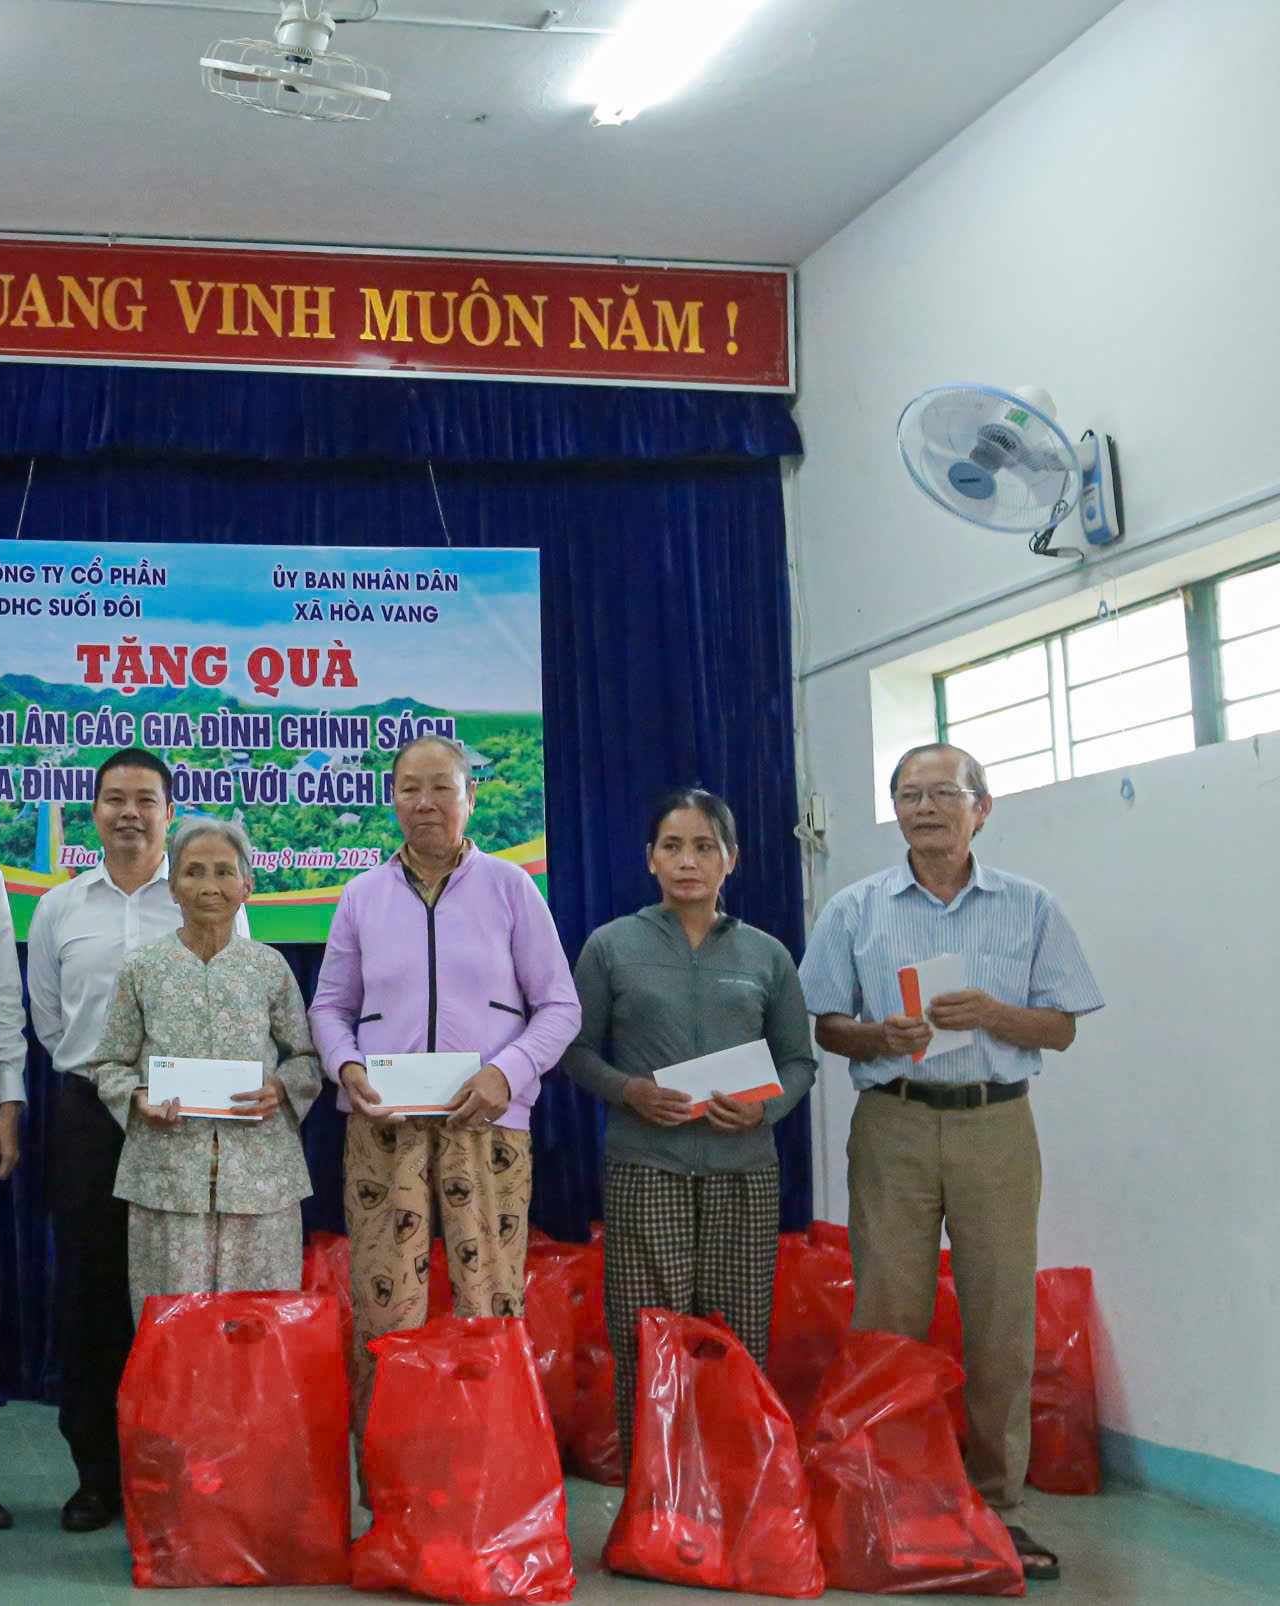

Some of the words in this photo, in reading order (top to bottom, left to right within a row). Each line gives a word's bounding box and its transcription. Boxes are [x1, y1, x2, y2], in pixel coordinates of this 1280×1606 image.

[170, 279, 336, 339] VINH
[359, 277, 548, 349] MUÔN
[569, 284, 705, 354] NĂM
[726, 301, 738, 355] !
[41, 566, 64, 584] TY
[70, 557, 104, 585] CỔ
[110, 559, 166, 586] PHẦN
[273, 564, 298, 589] ỦY
[305, 571, 346, 590] BAN
[352, 568, 409, 591] NHÂN
[416, 569, 458, 592] DÂN
[48, 592, 96, 617] SUỐI
[103, 595, 141, 618] ĐÔI
[294, 599, 324, 621] XÃ
[330, 599, 375, 622] HÒA
[381, 605, 439, 623] VANG
[77, 636, 228, 694] TẶNG
[247, 640, 358, 698] QUÀ
[24, 706, 65, 745] ÂN
[75, 707, 134, 746] CÁC
[143, 713, 193, 747] GIA
[200, 709, 270, 748] ĐÌNH
[280, 710, 369, 749] CHÍNH
[22, 761, 94, 801] ĐÌNH
[172, 763, 232, 802] ÔNG
[241, 764, 287, 803] VỚI
[297, 765, 373, 804] CÁCH
[60, 847, 97, 866] Hòa
[281, 849, 292, 867] 8
[297, 849, 334, 867] năm
[339, 849, 379, 867] 2025
